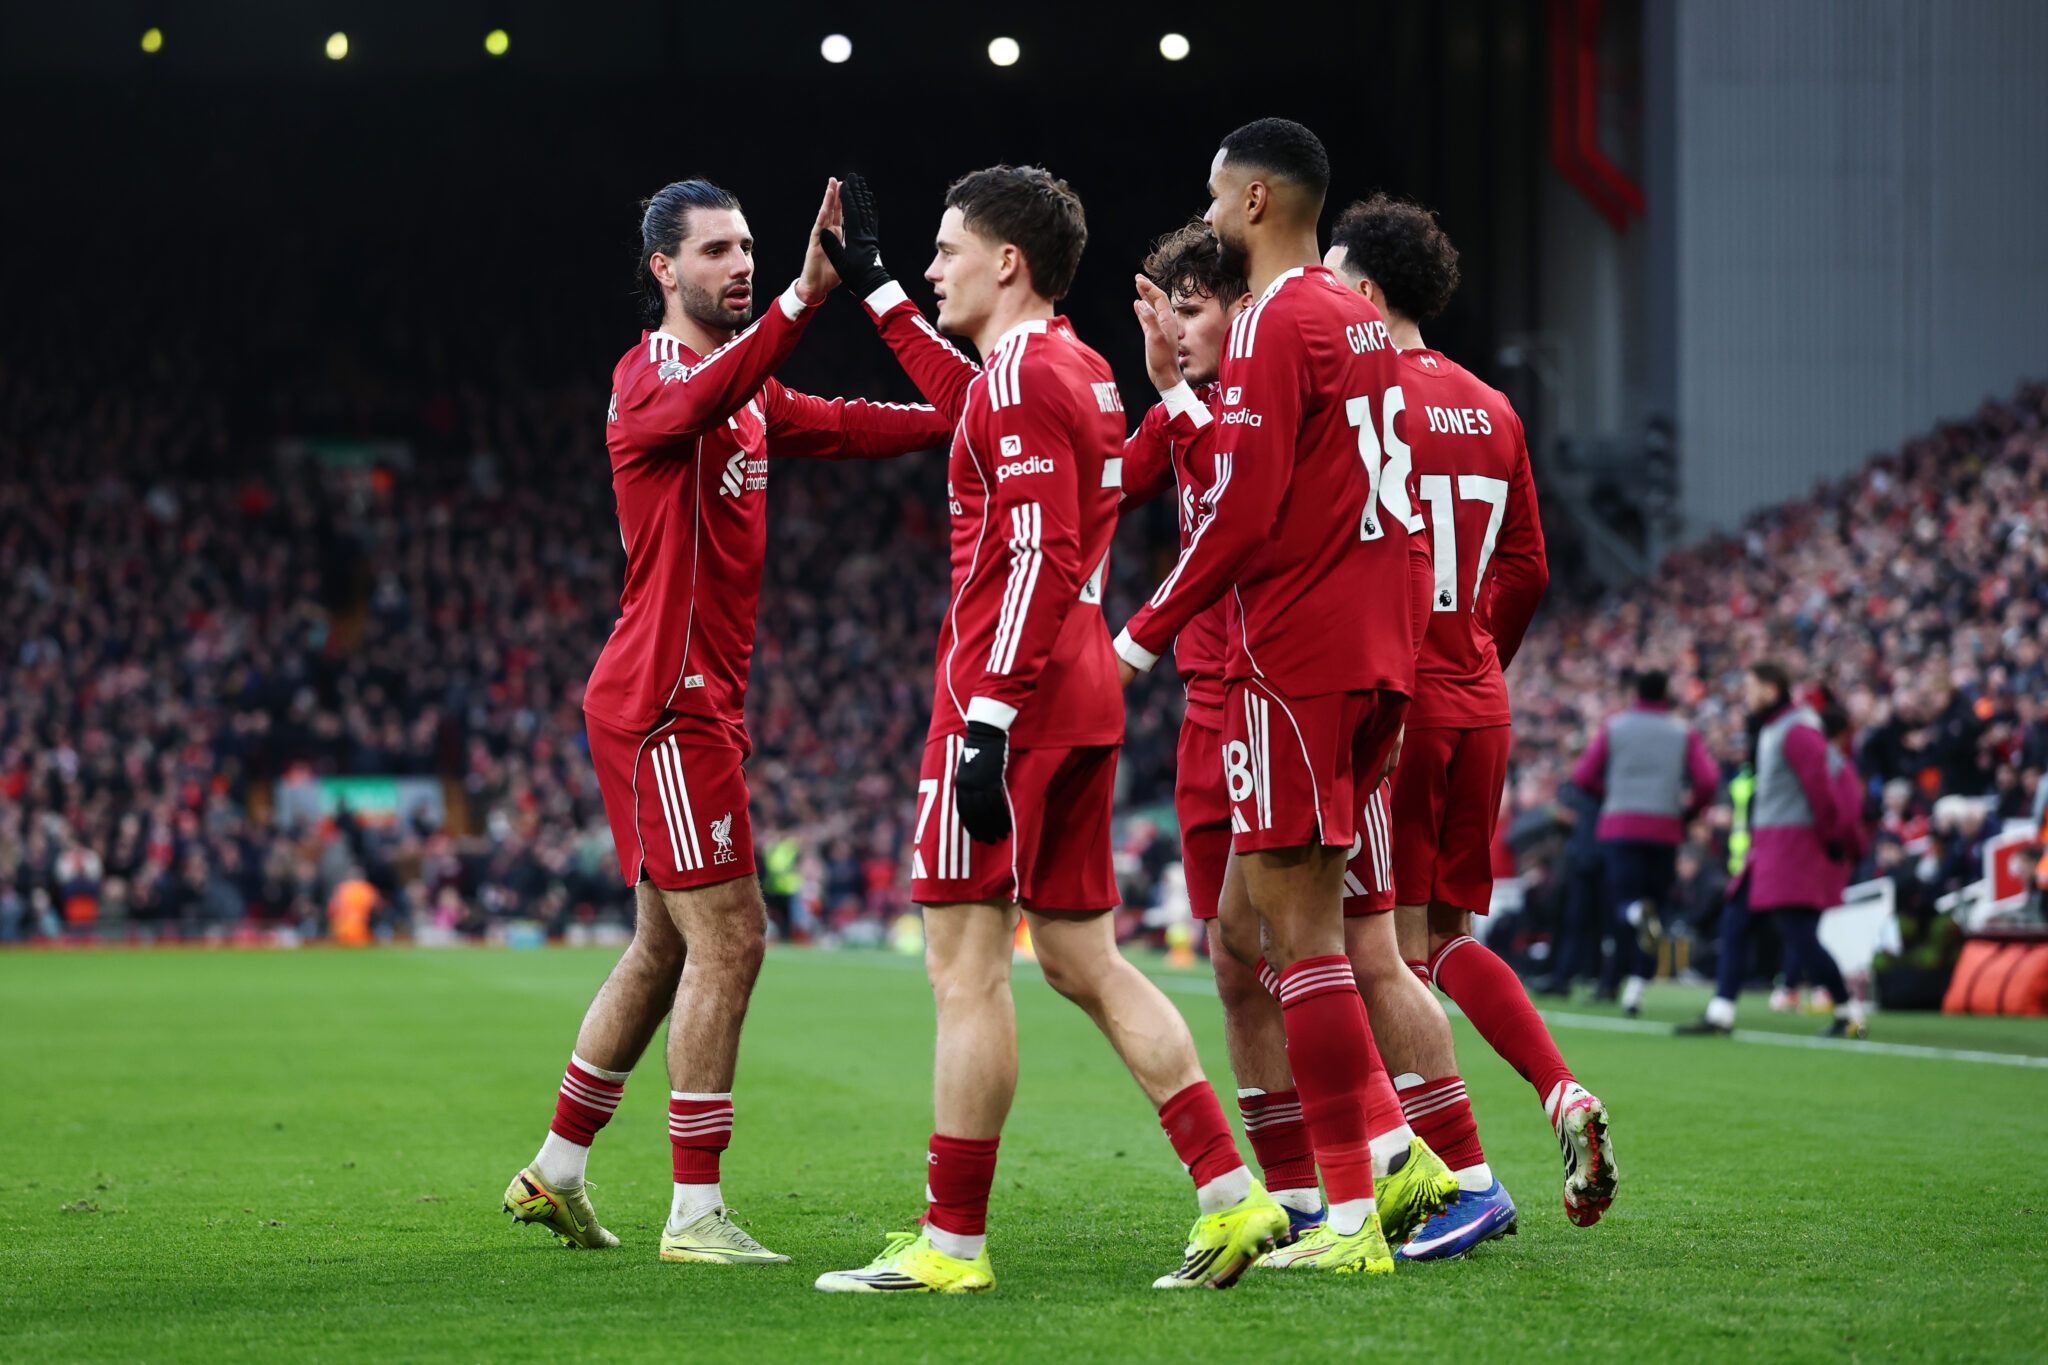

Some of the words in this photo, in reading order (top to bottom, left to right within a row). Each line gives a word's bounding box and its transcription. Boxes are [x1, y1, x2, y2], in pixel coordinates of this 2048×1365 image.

[1345, 320, 1397, 355] GAKP
[1424, 405, 1493, 435] JONES
[996, 455, 1055, 484] pedia
[1345, 385, 1413, 542] 18
[1419, 474, 1509, 614] 17
[914, 779, 939, 844] 7
[713, 851, 738, 865] L.F.C.
